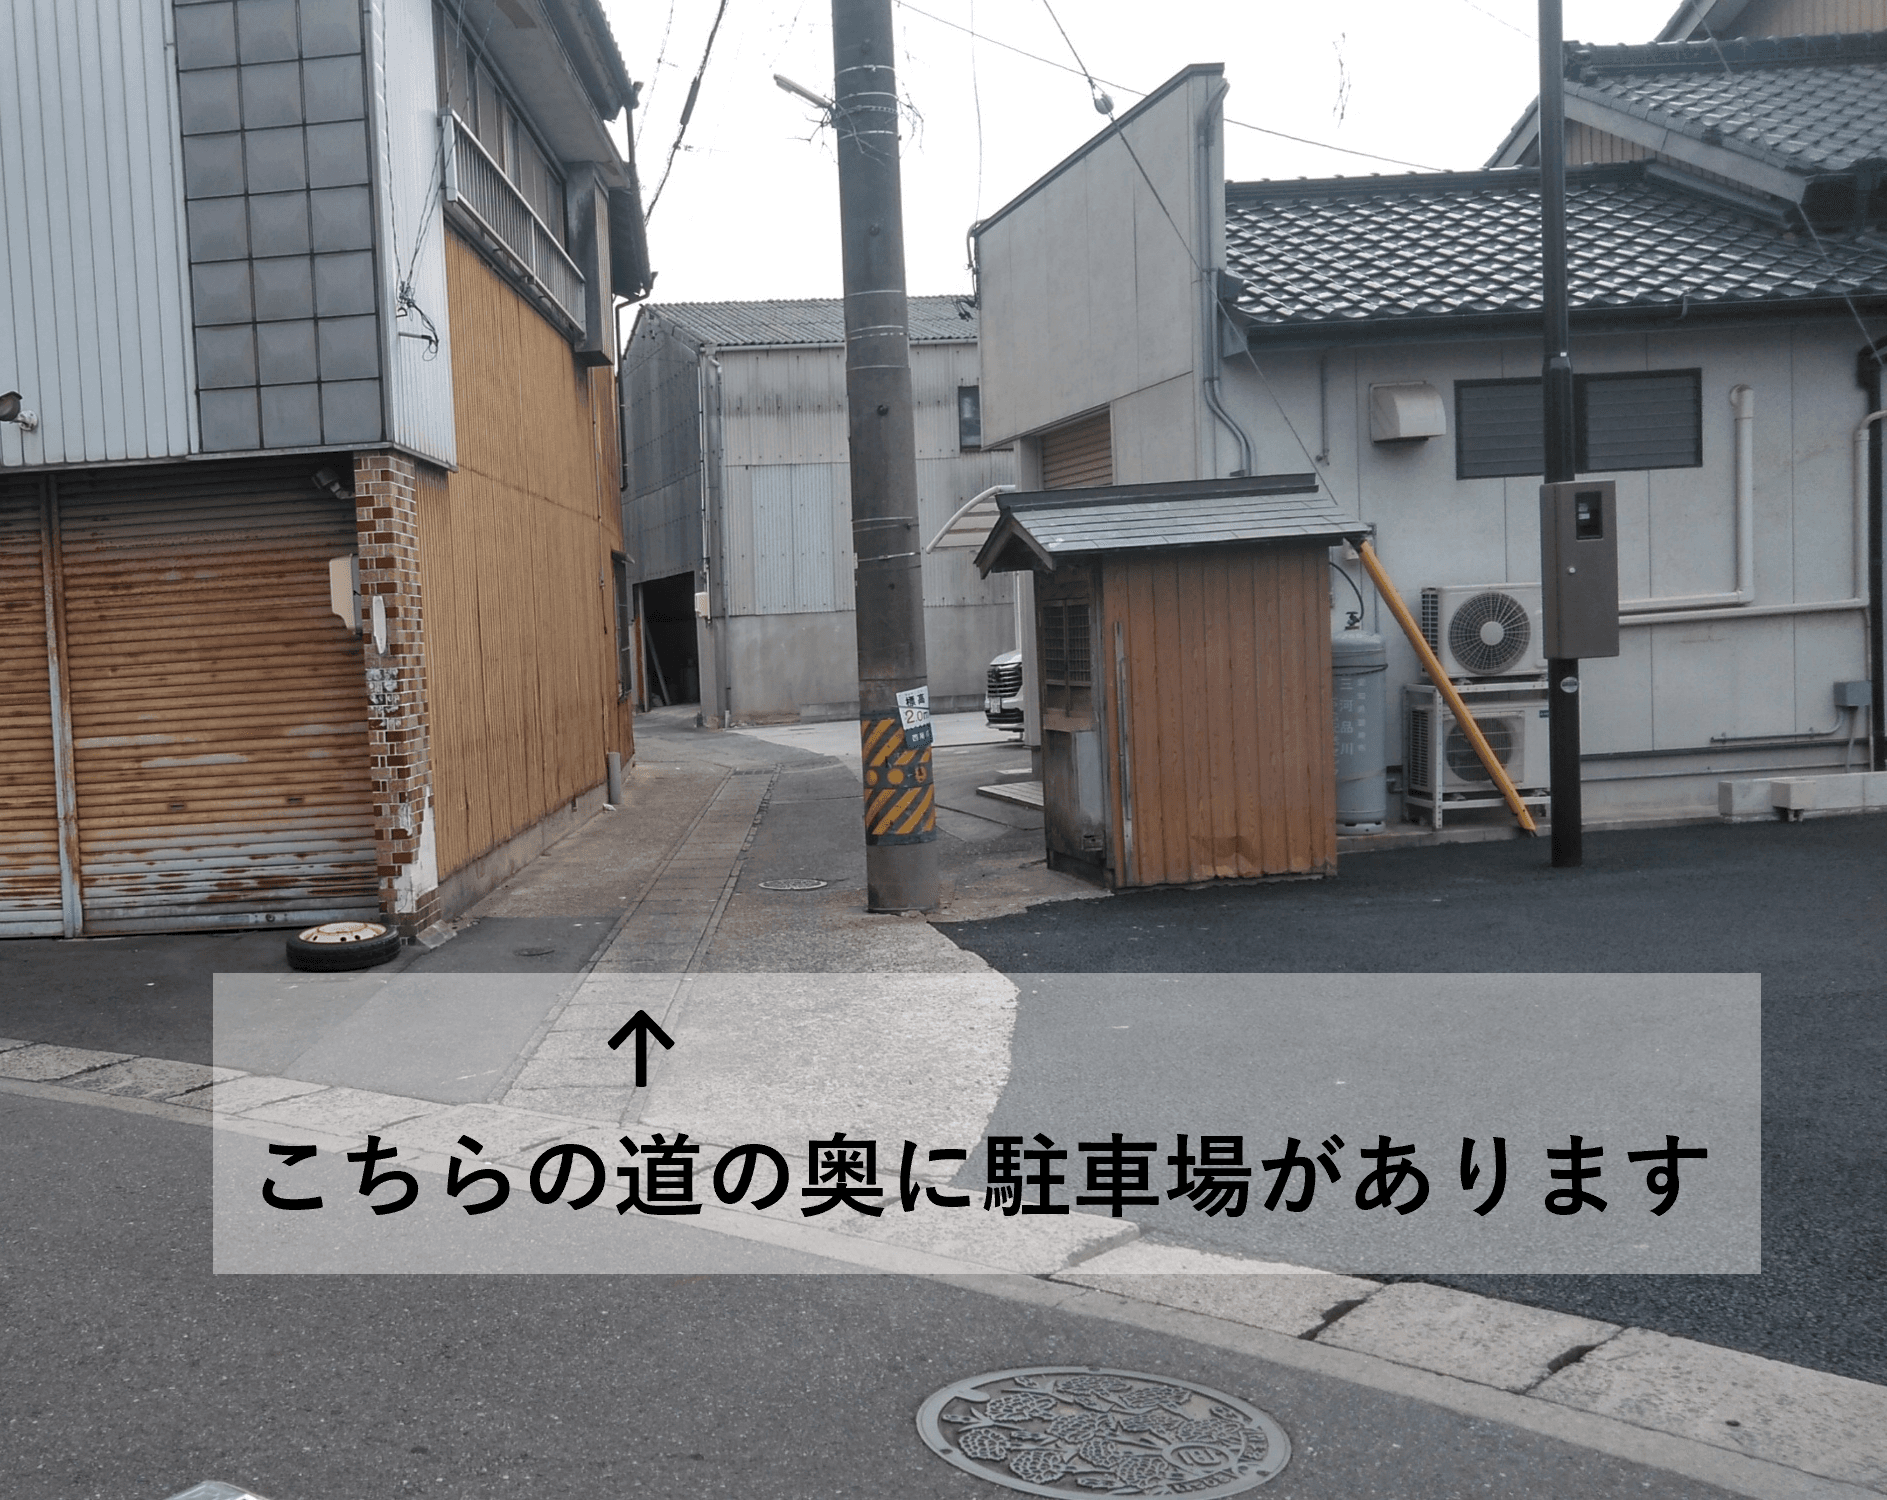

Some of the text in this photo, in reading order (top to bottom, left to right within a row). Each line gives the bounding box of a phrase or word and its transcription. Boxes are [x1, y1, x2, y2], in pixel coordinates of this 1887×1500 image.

[905, 693, 925, 706] 標高
[1340, 678, 1353, 756] 三河品川
